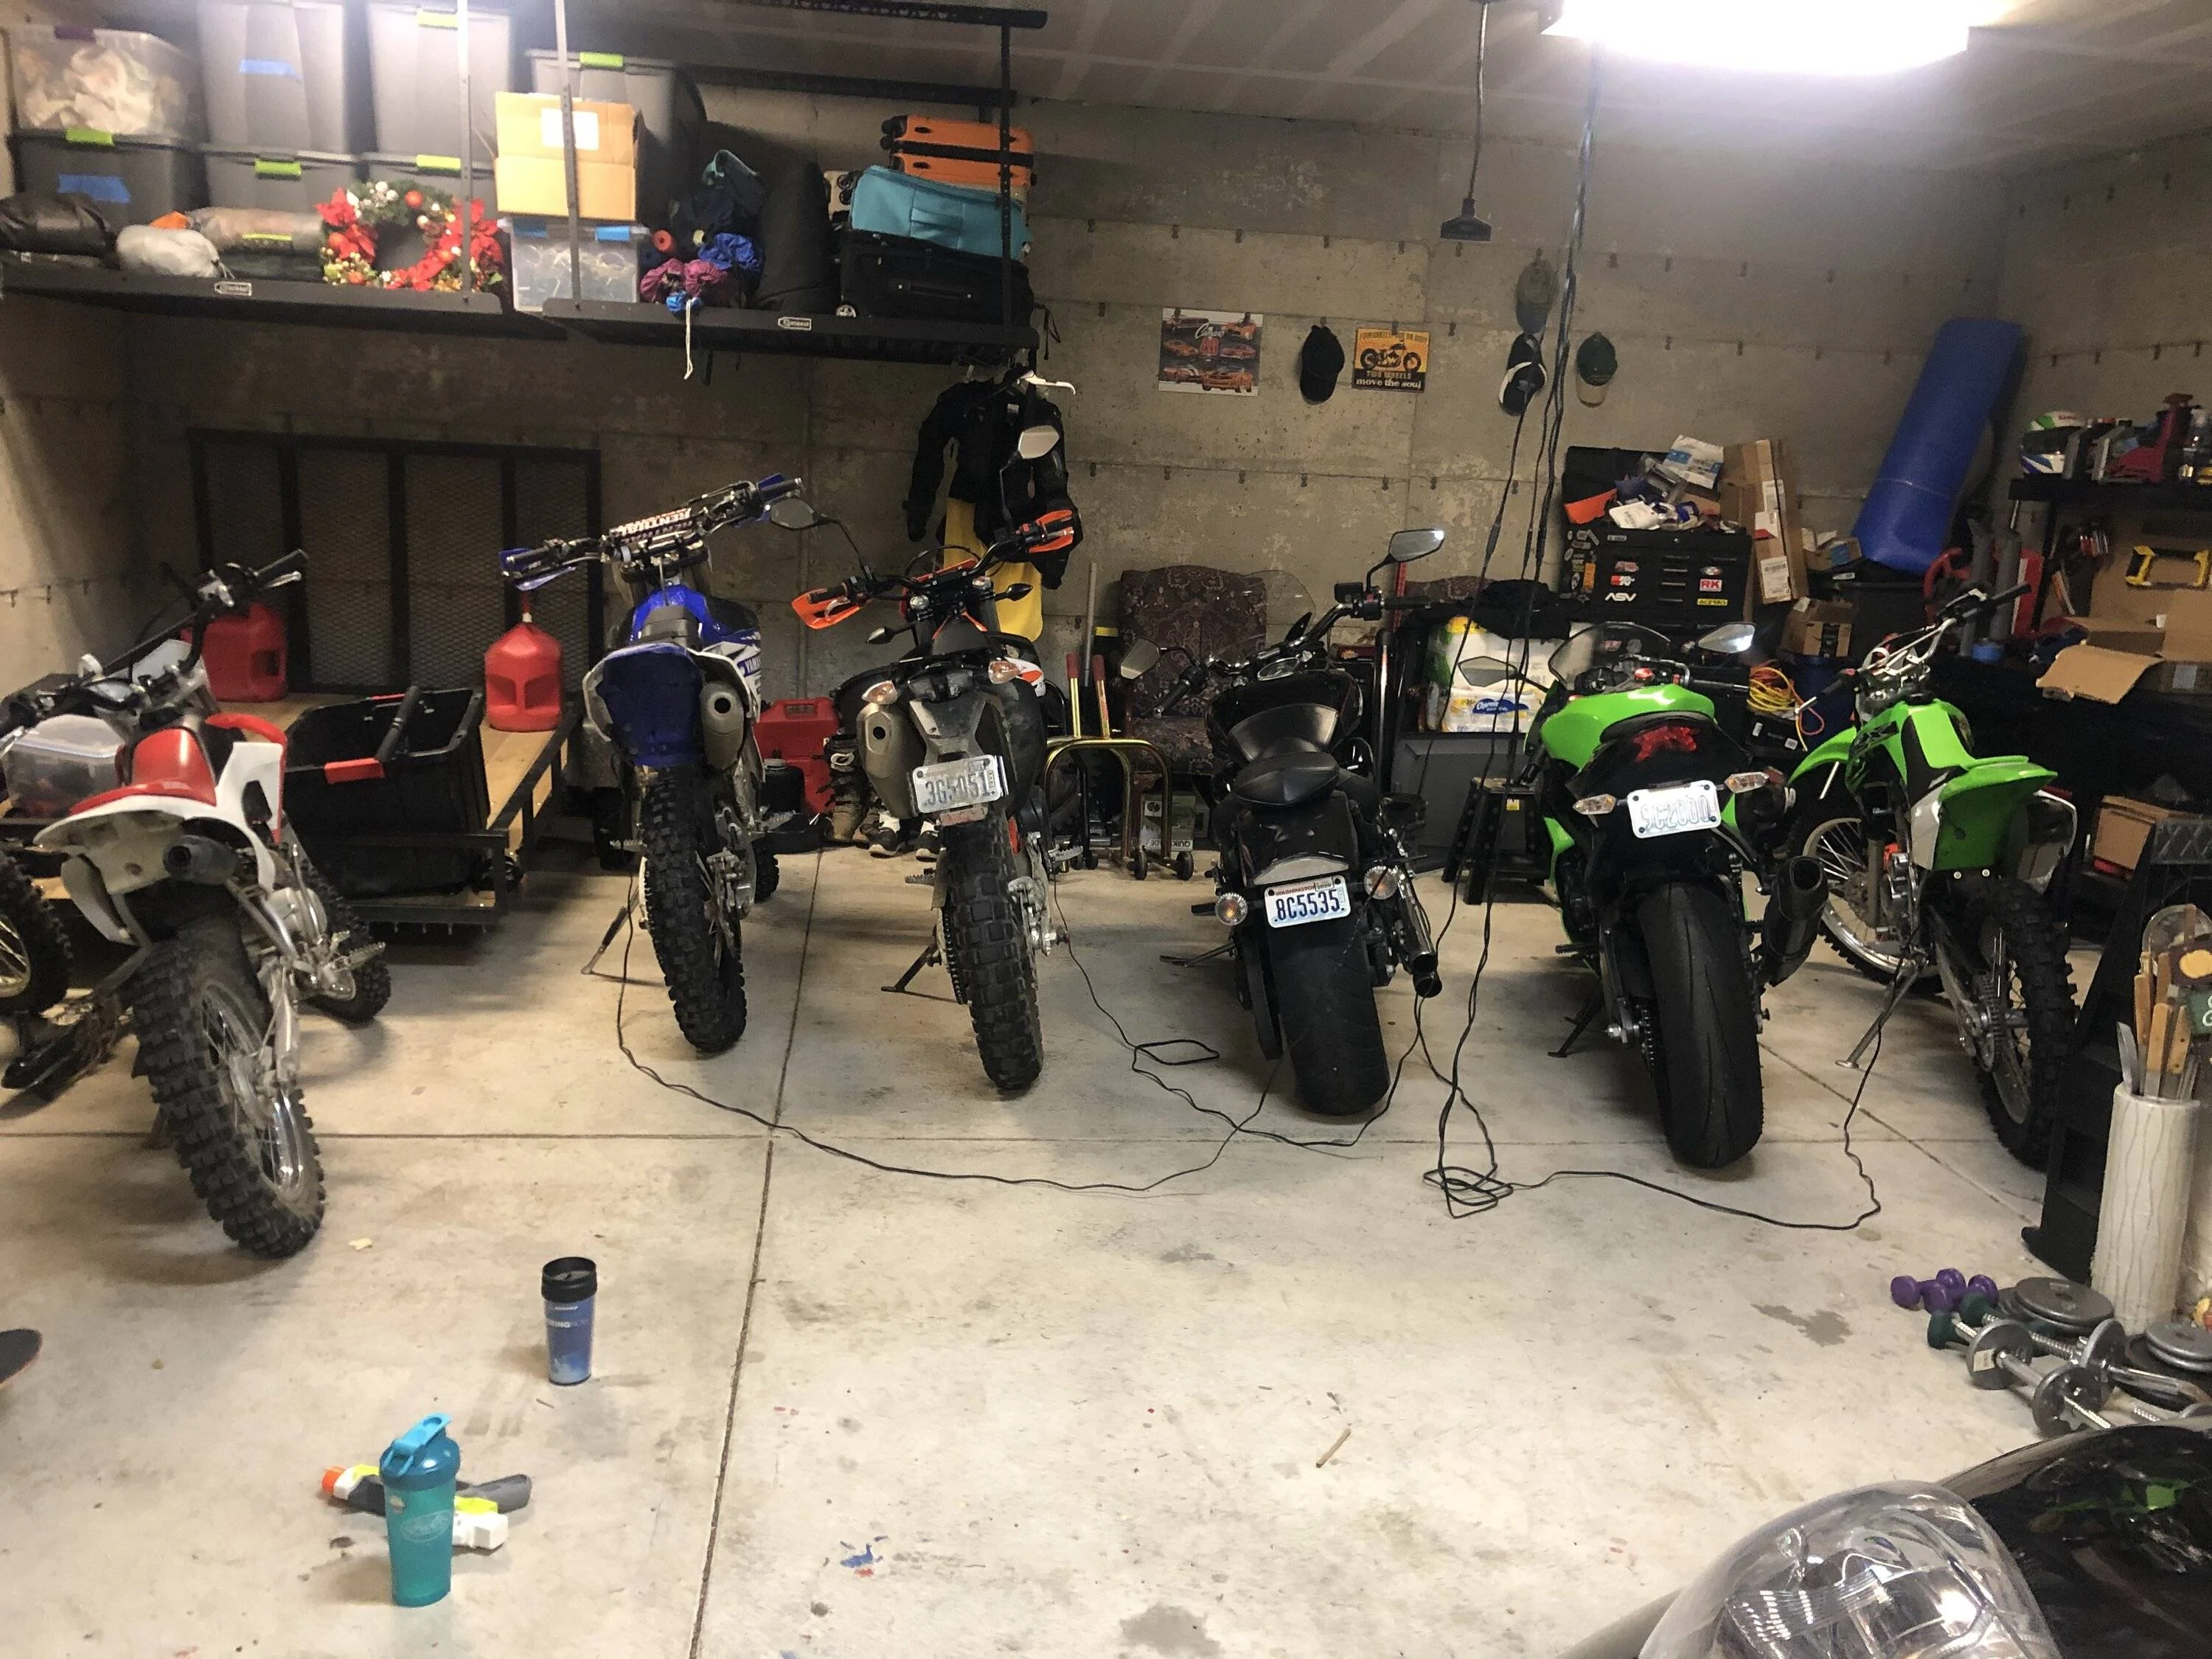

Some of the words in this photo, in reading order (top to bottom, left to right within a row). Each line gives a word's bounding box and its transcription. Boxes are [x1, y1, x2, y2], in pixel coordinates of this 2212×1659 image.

[1385, 378, 1400, 386] the
[1402, 380, 1422, 389] soul
[1701, 580, 1719, 588] RK
[1604, 592, 1637, 602] ASV
[1276, 888, 1340, 921] 8C5535
